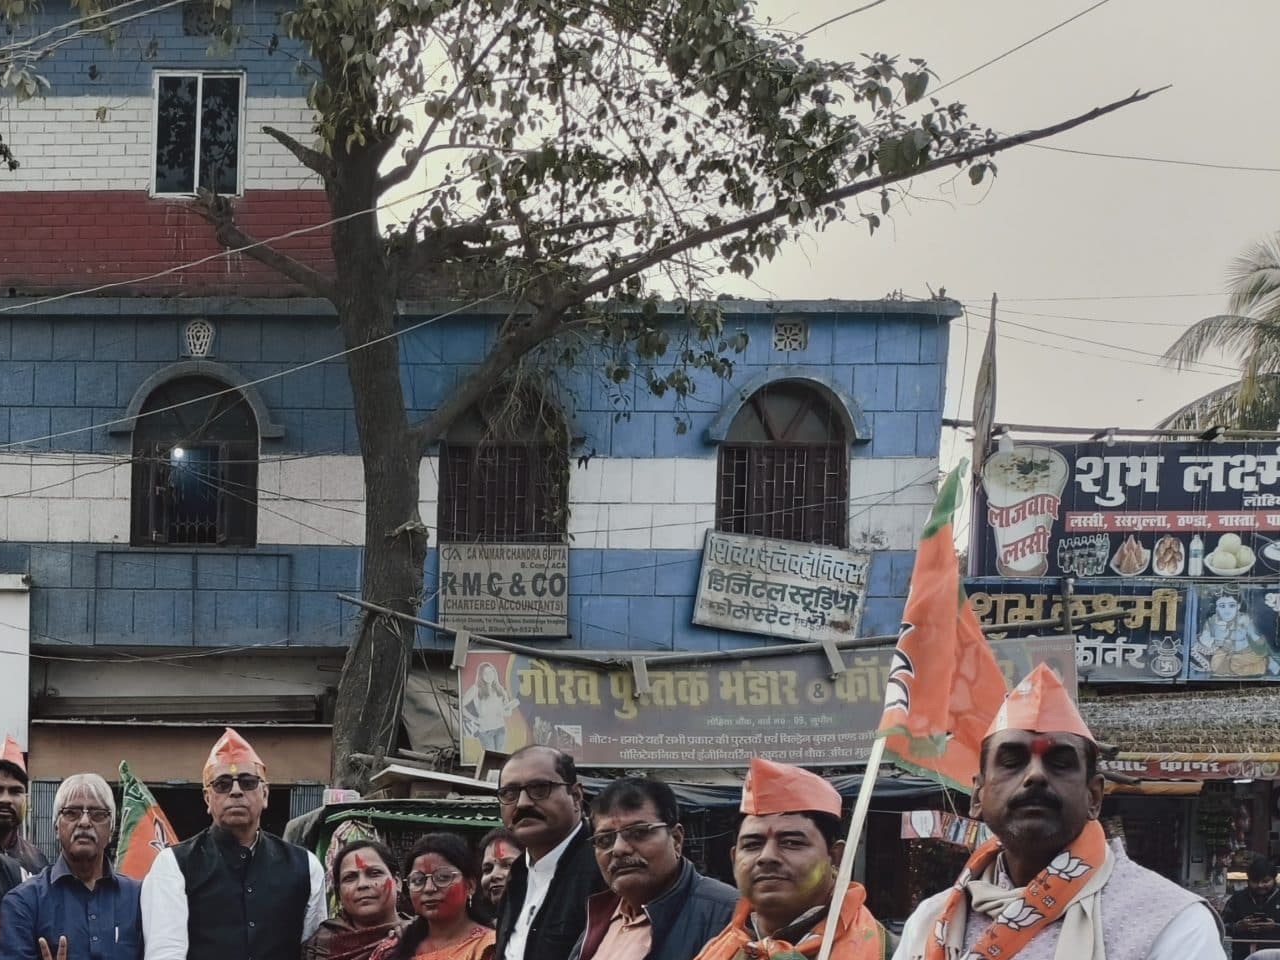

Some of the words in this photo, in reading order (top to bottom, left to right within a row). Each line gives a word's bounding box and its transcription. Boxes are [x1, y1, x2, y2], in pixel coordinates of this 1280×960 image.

[1075, 456, 1165, 507] शुभ
[987, 492, 1061, 529] लाजवाब
[467, 548, 476, 560] CA
[479, 548, 506, 560] KUMAR
[507, 548, 540, 561] CHANDRA
[542, 549, 567, 561] GUPTA
[1002, 524, 1051, 567] लस्सी
[509, 572, 526, 597] &
[532, 572, 566, 597] CO
[708, 568, 789, 603] डिजिटल
[519, 658, 601, 705] गौरव
[813, 683, 825, 699] &
